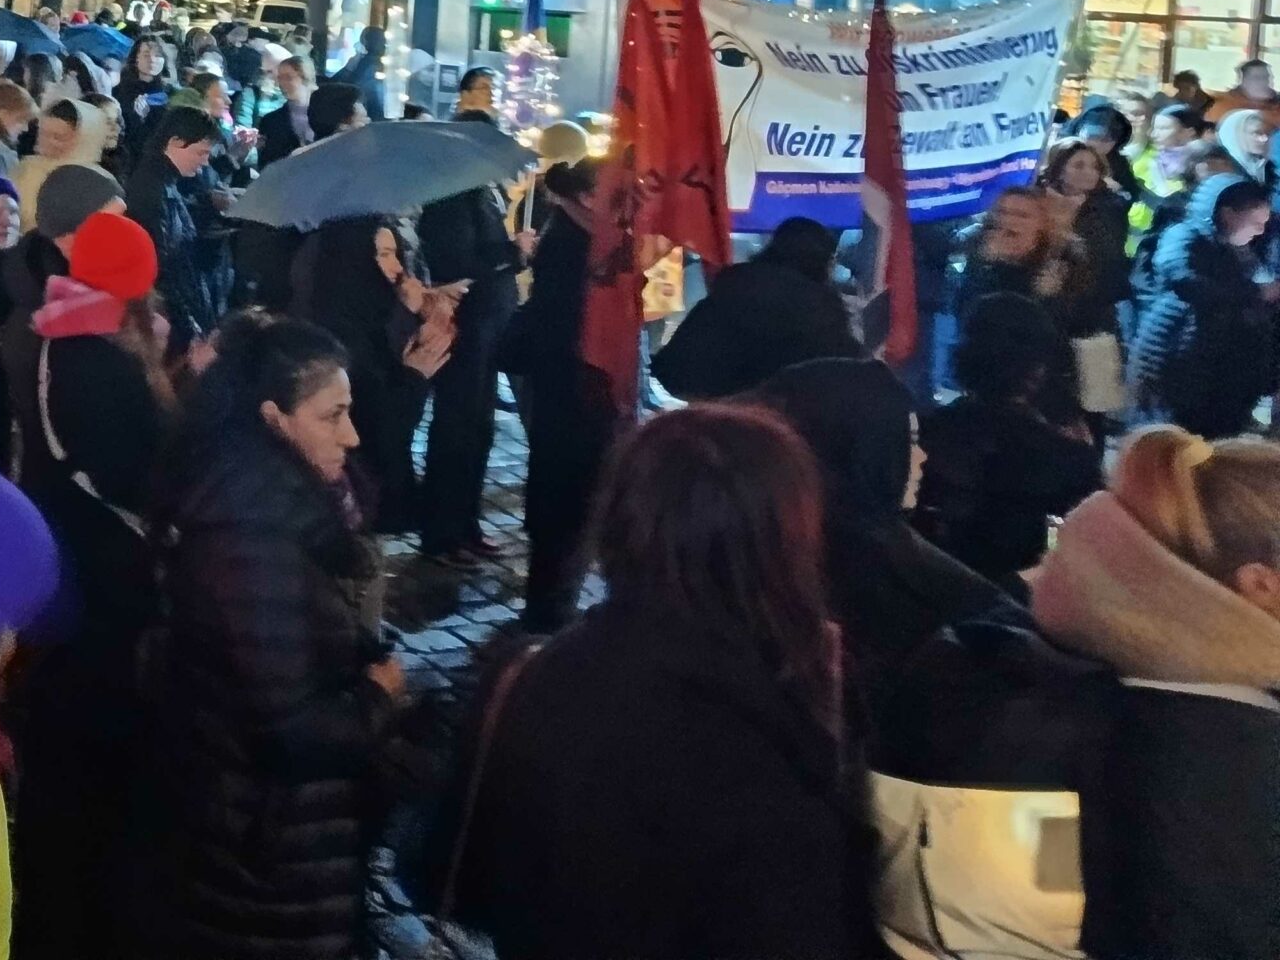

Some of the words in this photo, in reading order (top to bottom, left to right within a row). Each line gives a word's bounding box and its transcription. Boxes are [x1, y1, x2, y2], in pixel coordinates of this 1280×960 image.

[765, 41, 831, 74] Nein
[827, 53, 868, 76] zu
[765, 121, 836, 157] Nein
[841, 133, 867, 159] z
